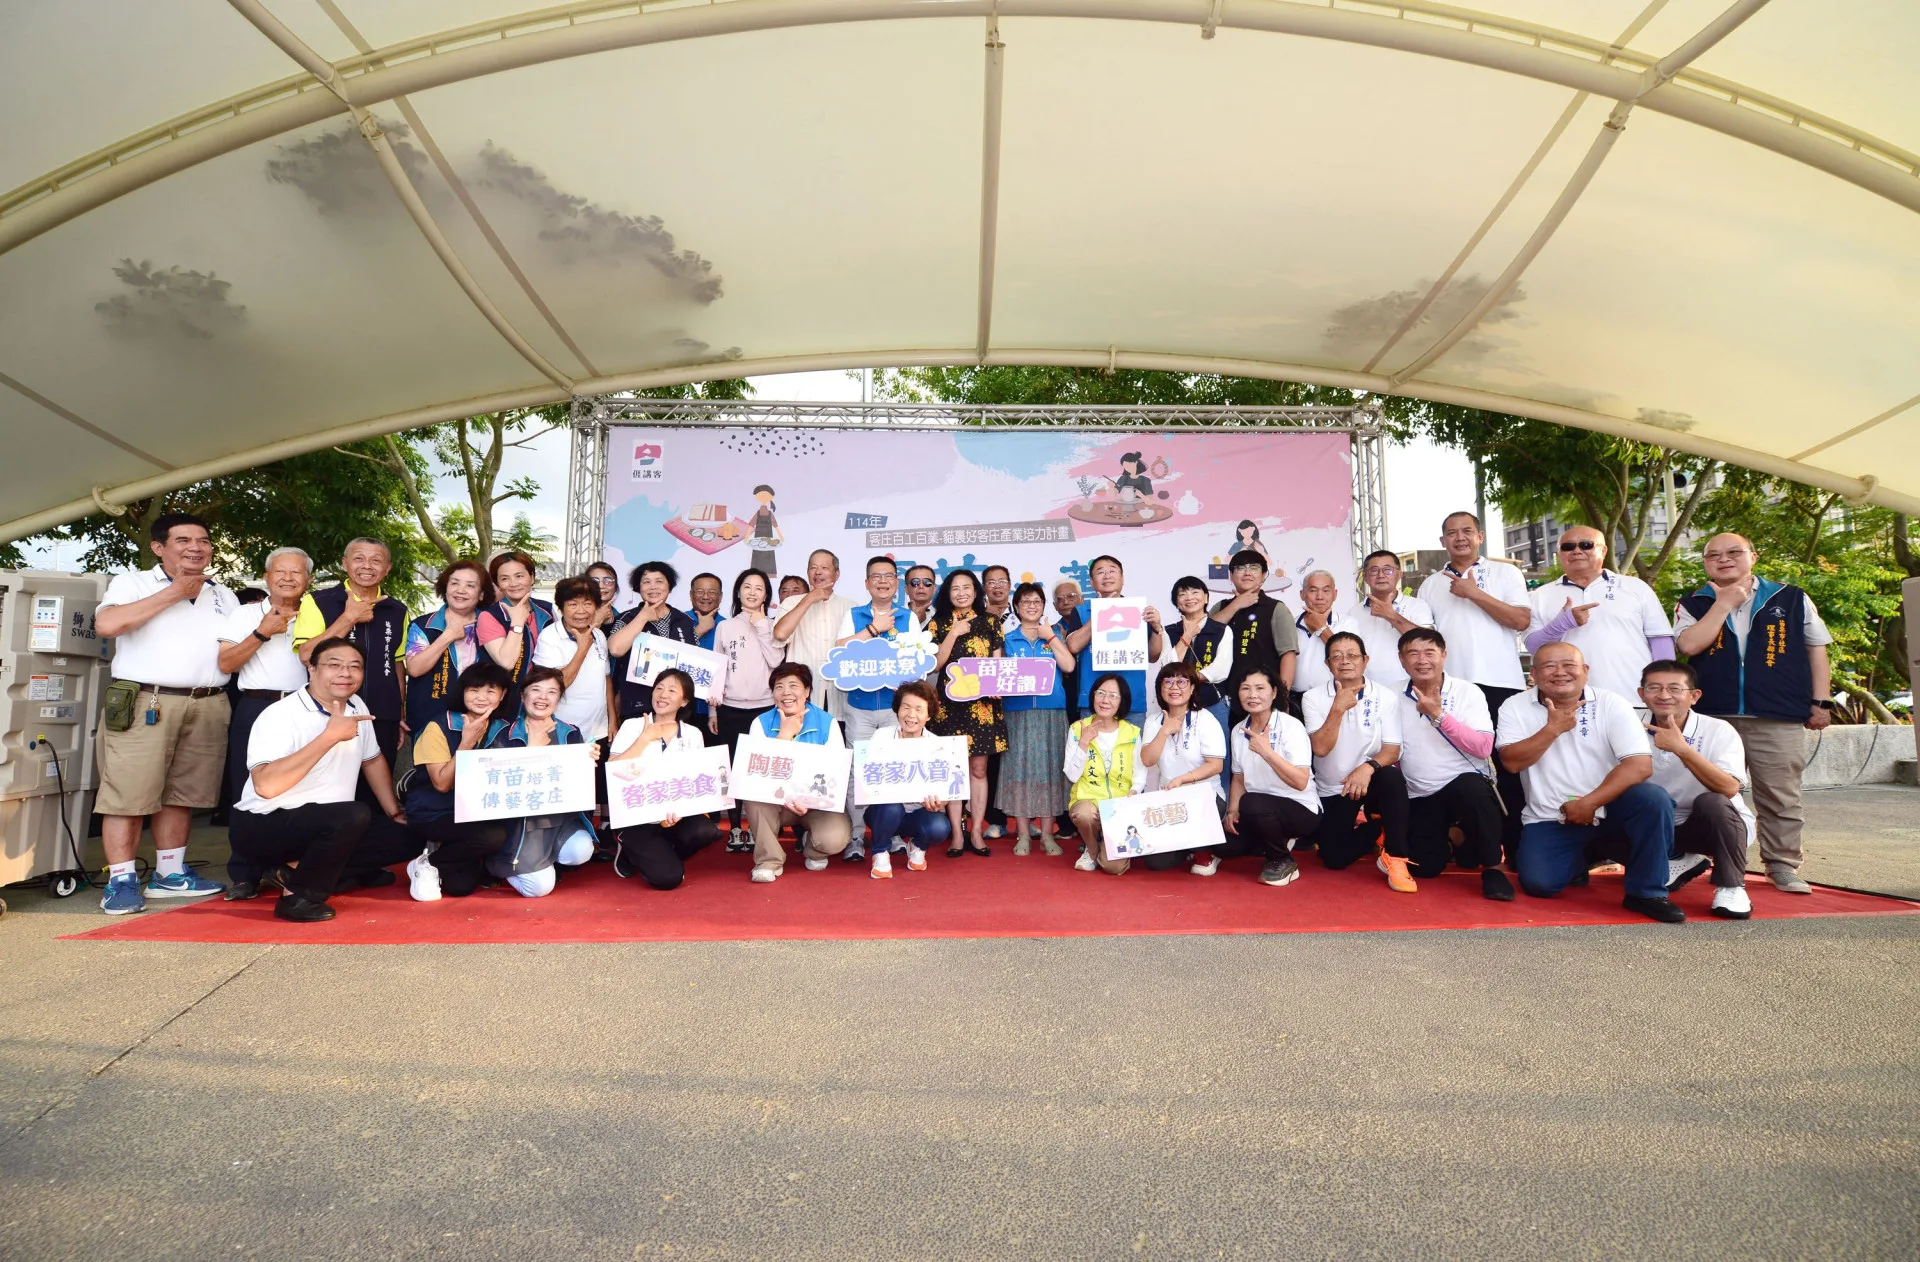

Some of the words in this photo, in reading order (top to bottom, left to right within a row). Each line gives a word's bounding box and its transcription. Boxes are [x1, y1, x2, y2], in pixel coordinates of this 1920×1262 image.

[848, 515, 883, 529] 114年
[977, 658, 1018, 677] 苗栗
[485, 764, 564, 788] 育苗培菁
[746, 752, 794, 781] 陶藝
[862, 758, 951, 786] 客家八音
[480, 786, 565, 811] 傳藝客庄
[622, 772, 717, 809] 客家美食
[1141, 801, 1189, 828] 布藝
